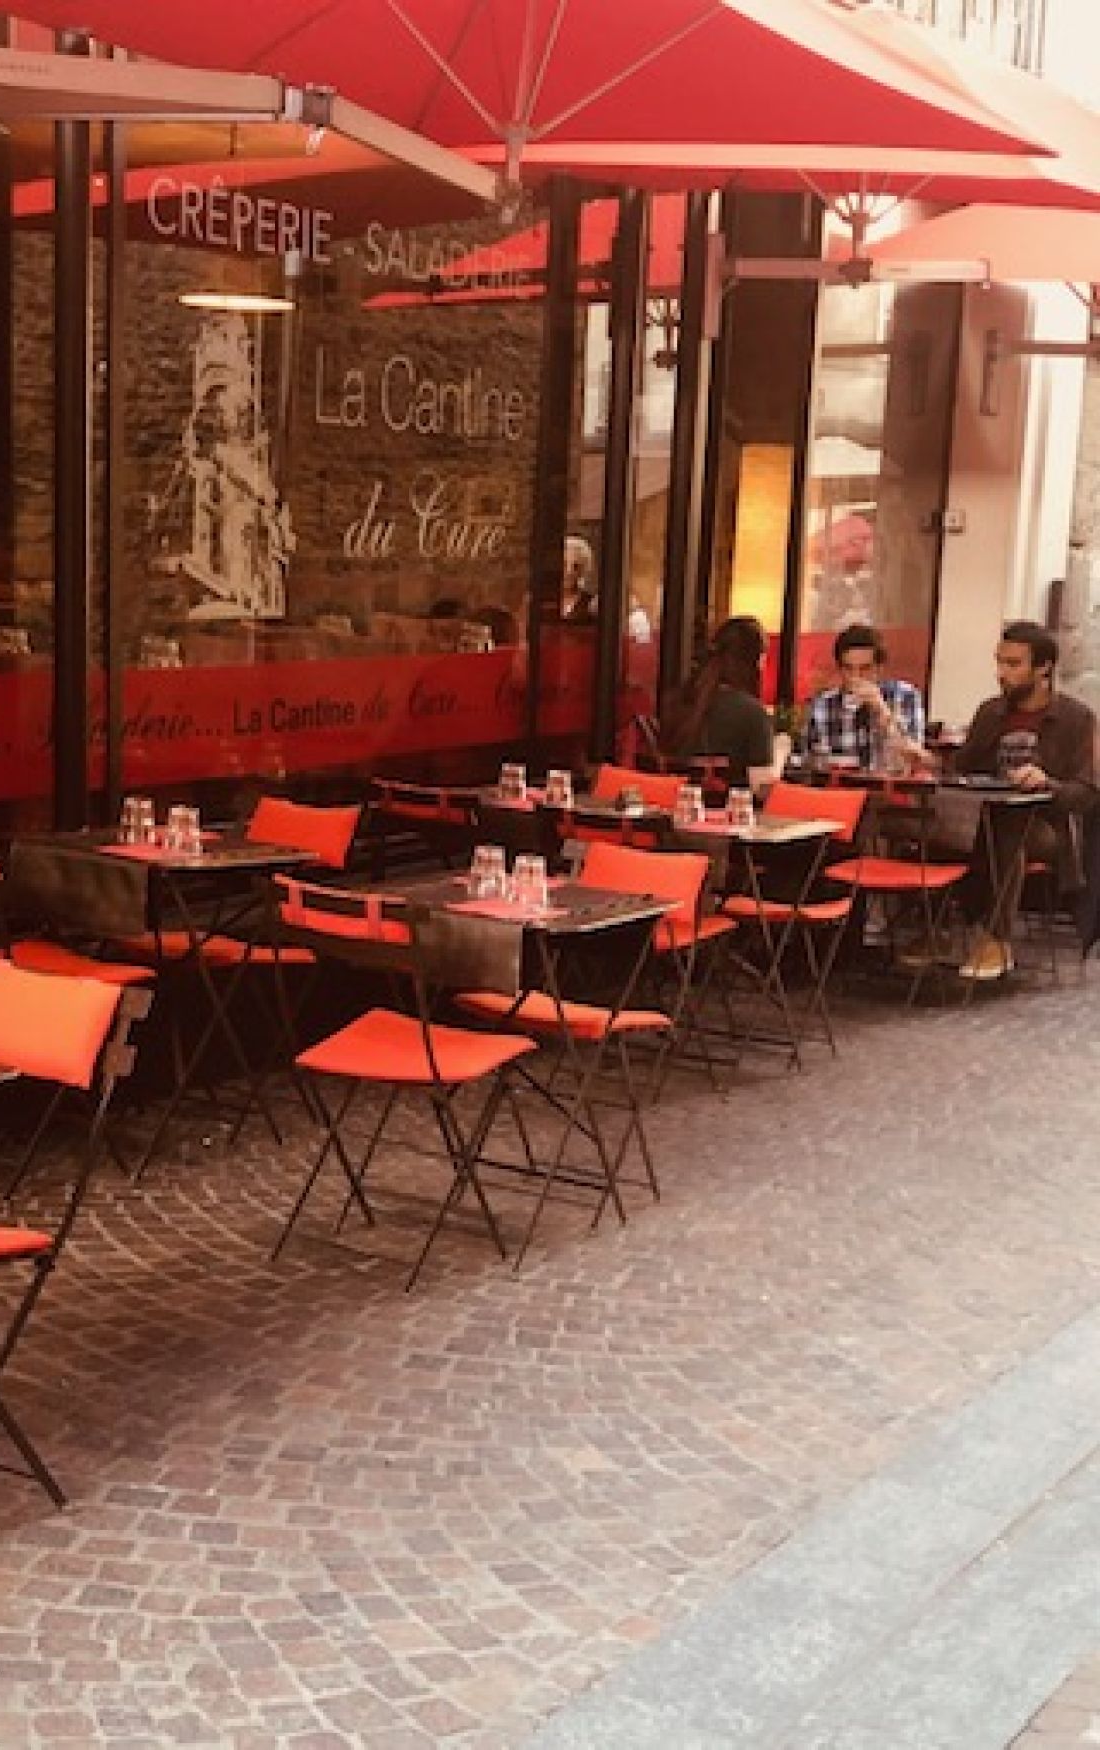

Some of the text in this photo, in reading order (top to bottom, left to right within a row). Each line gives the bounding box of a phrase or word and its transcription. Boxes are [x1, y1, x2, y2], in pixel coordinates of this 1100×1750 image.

[148, 174, 334, 265] CRÊPERIE
[315, 346, 525, 441] La Cantine
[343, 480, 396, 558] du
[232, 698, 262, 736] La
[270, 697, 356, 734] Cantine
